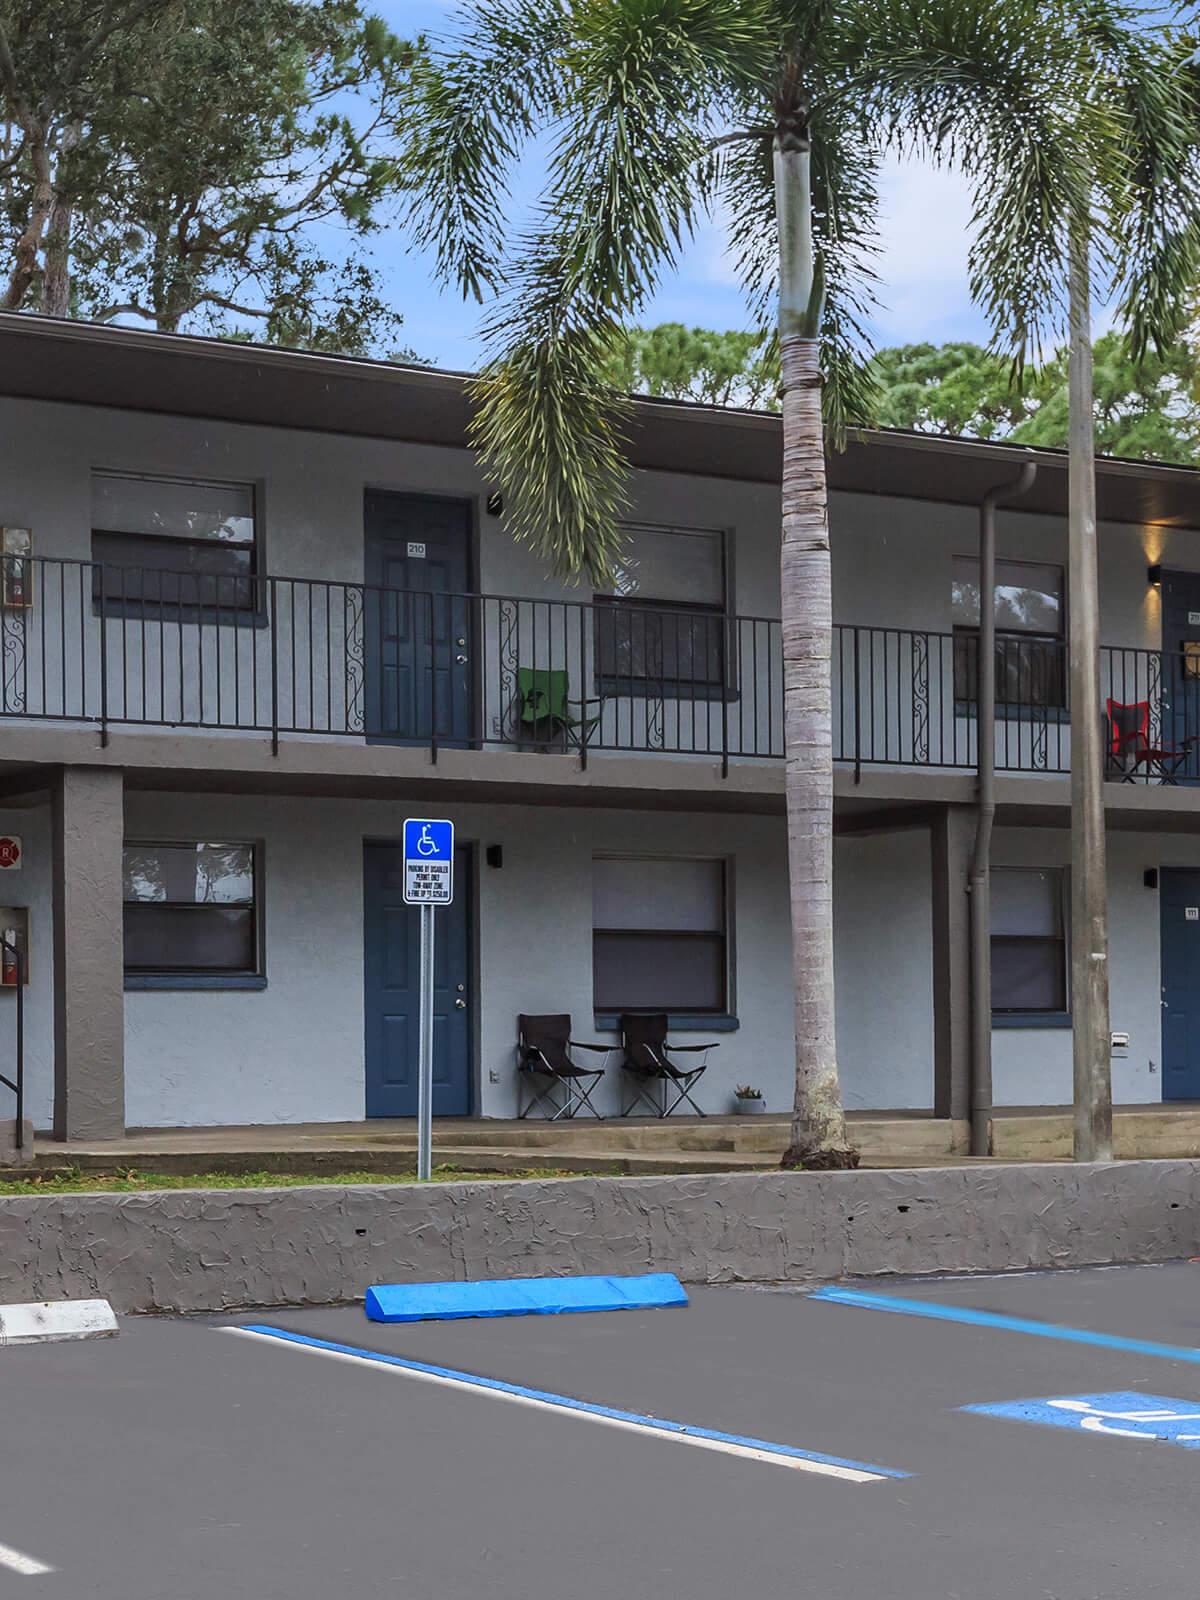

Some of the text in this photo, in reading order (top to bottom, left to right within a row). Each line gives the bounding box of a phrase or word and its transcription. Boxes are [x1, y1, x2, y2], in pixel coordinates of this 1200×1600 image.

[409, 544, 424, 553] 210
[2, 847, 9, 857] R
[416, 873, 430, 881] PERMIT
